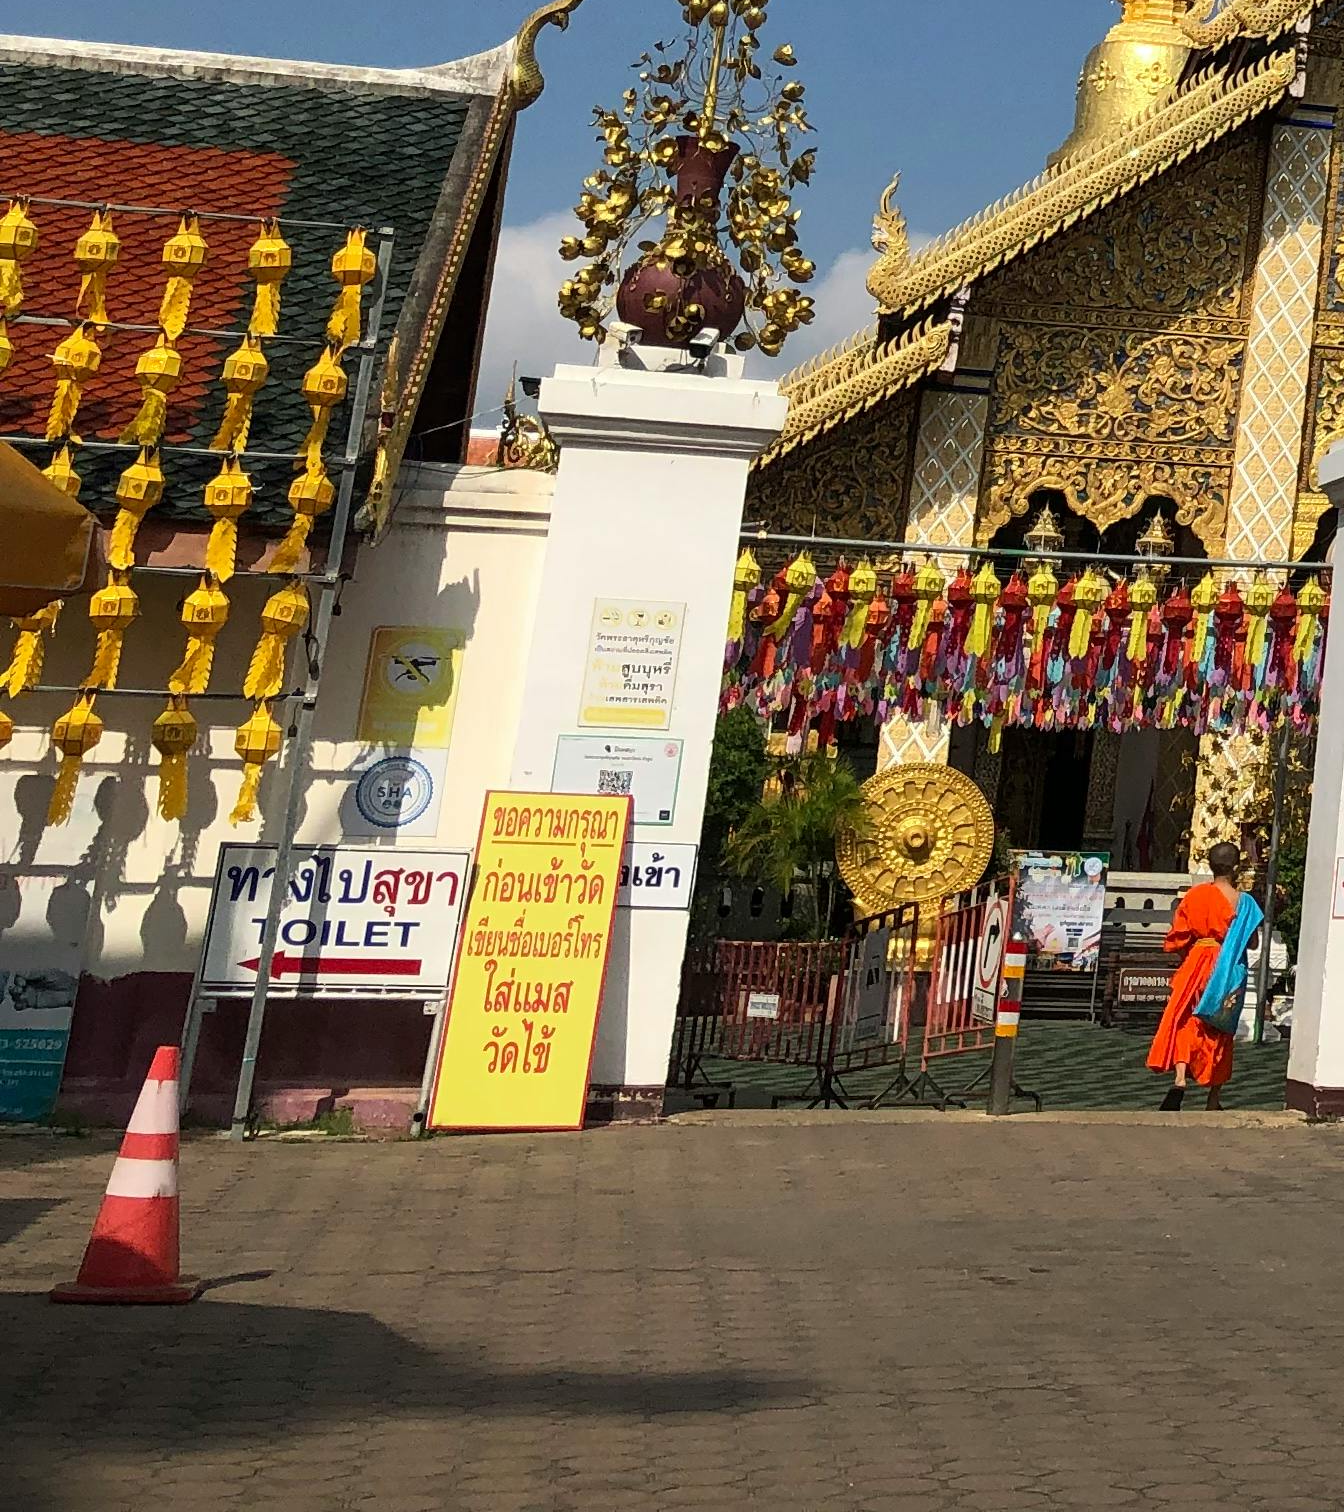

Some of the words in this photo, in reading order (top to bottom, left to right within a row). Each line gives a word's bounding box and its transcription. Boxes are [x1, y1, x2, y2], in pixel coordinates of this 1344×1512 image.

[377, 785, 412, 798] SHA
[493, 806, 619, 858] ขอความกรุณา
[482, 857, 605, 904] ก่อนเข้าวัด
[252, 918, 420, 948] TOILET
[484, 959, 574, 1014] ใส่แมส
[483, 1019, 556, 1073] วัดไข้
